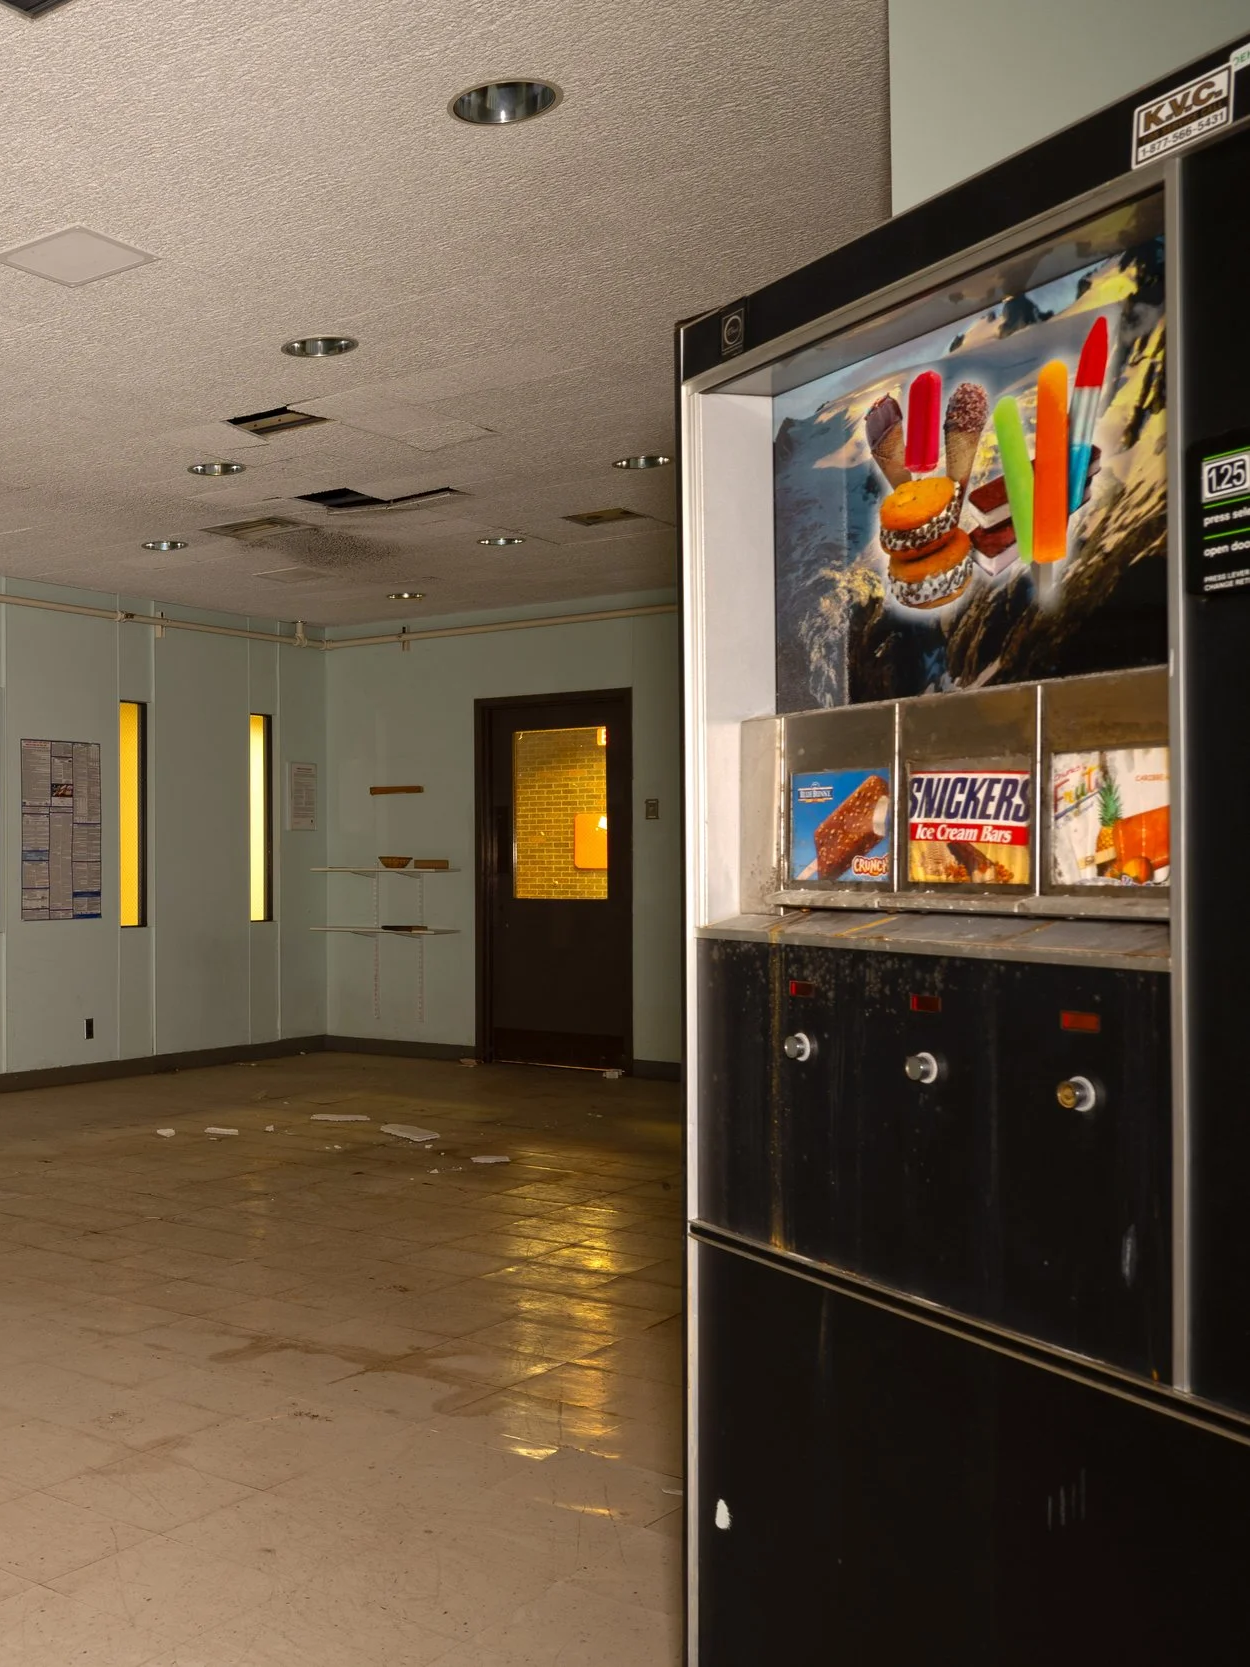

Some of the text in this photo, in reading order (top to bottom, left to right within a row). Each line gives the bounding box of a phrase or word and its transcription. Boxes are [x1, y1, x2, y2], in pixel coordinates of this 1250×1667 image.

[1143, 81, 1223, 133] K.V.C.
[1203, 512, 1231, 527] press
[1203, 543, 1230, 558] open
[1203, 572, 1227, 584] PRESS
[1203, 579, 1234, 592] CHANGE
[910, 777, 1030, 823] SNICKERS
[915, 823, 1013, 843] Ice Cream Bars
